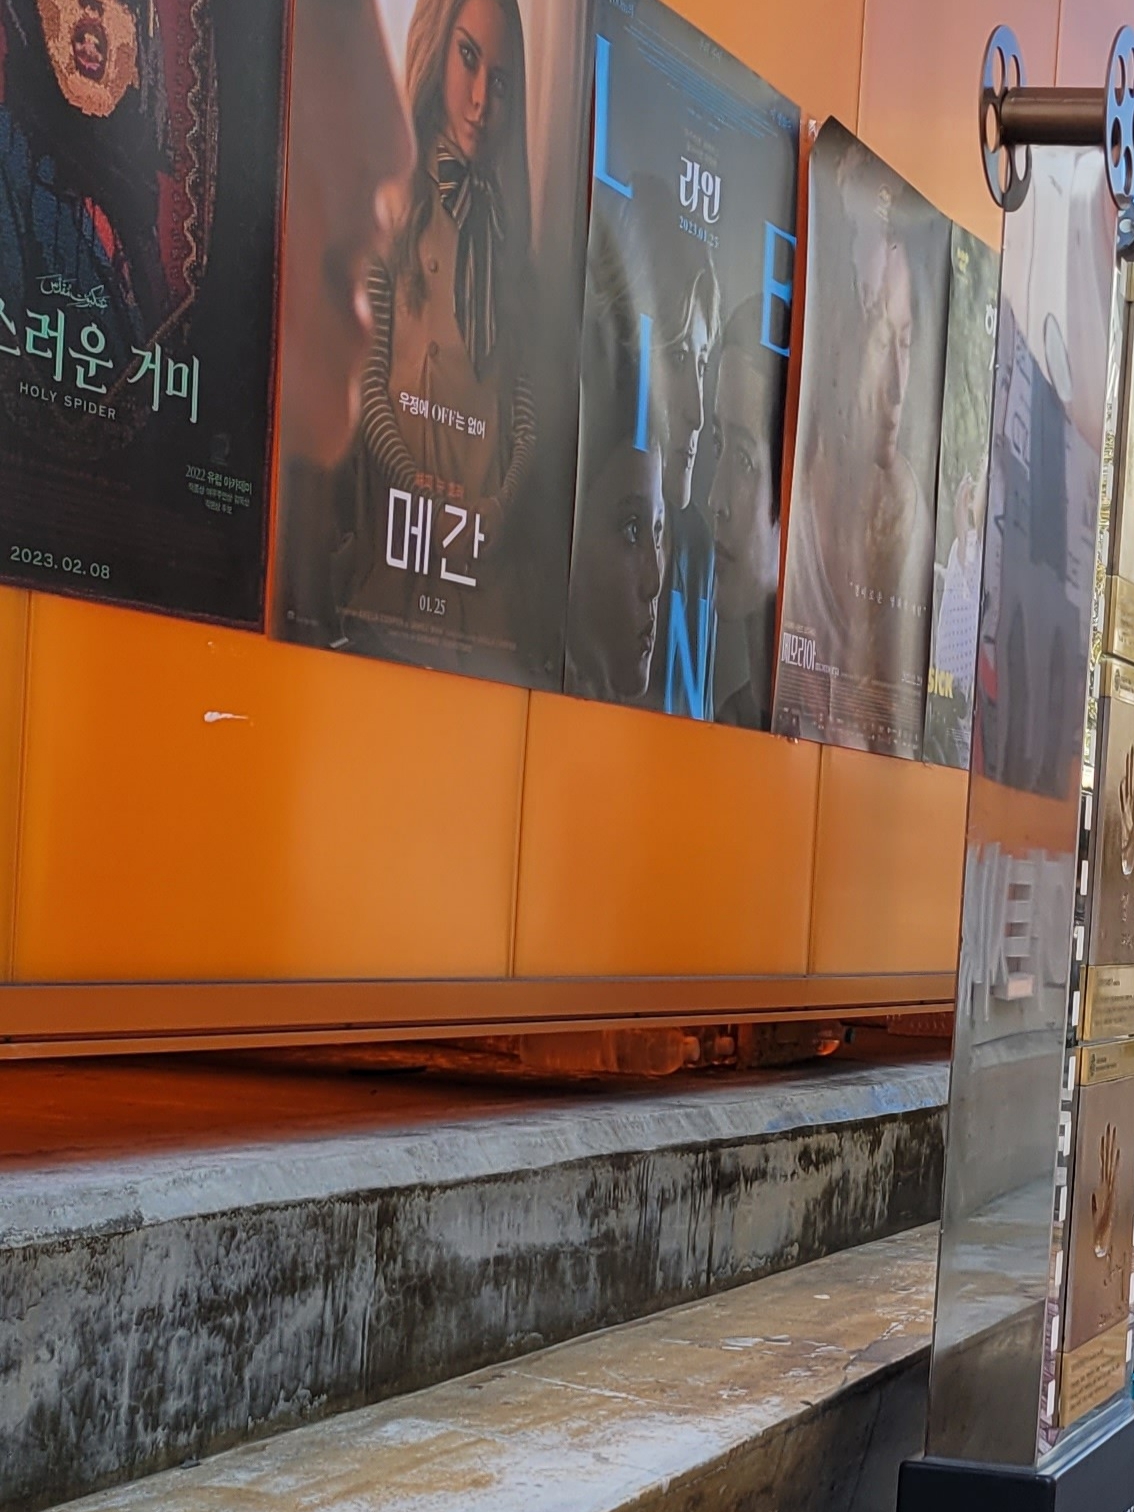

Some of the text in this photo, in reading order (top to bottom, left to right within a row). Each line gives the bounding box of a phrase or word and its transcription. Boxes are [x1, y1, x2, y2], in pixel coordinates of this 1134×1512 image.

[680, 156, 721, 223] 라인
[20, 382, 116, 420] HOLY SPIDER
[127, 342, 200, 424] 거미
[399, 391, 429, 418] 우정에
[468, 416, 486, 439] 없어
[185, 465, 206, 481] 2022
[207, 471, 223, 487] 유럽
[386, 488, 484, 587] 메간
[781, 632, 816, 671] 메모리아
[928, 666, 954, 699] SICK
